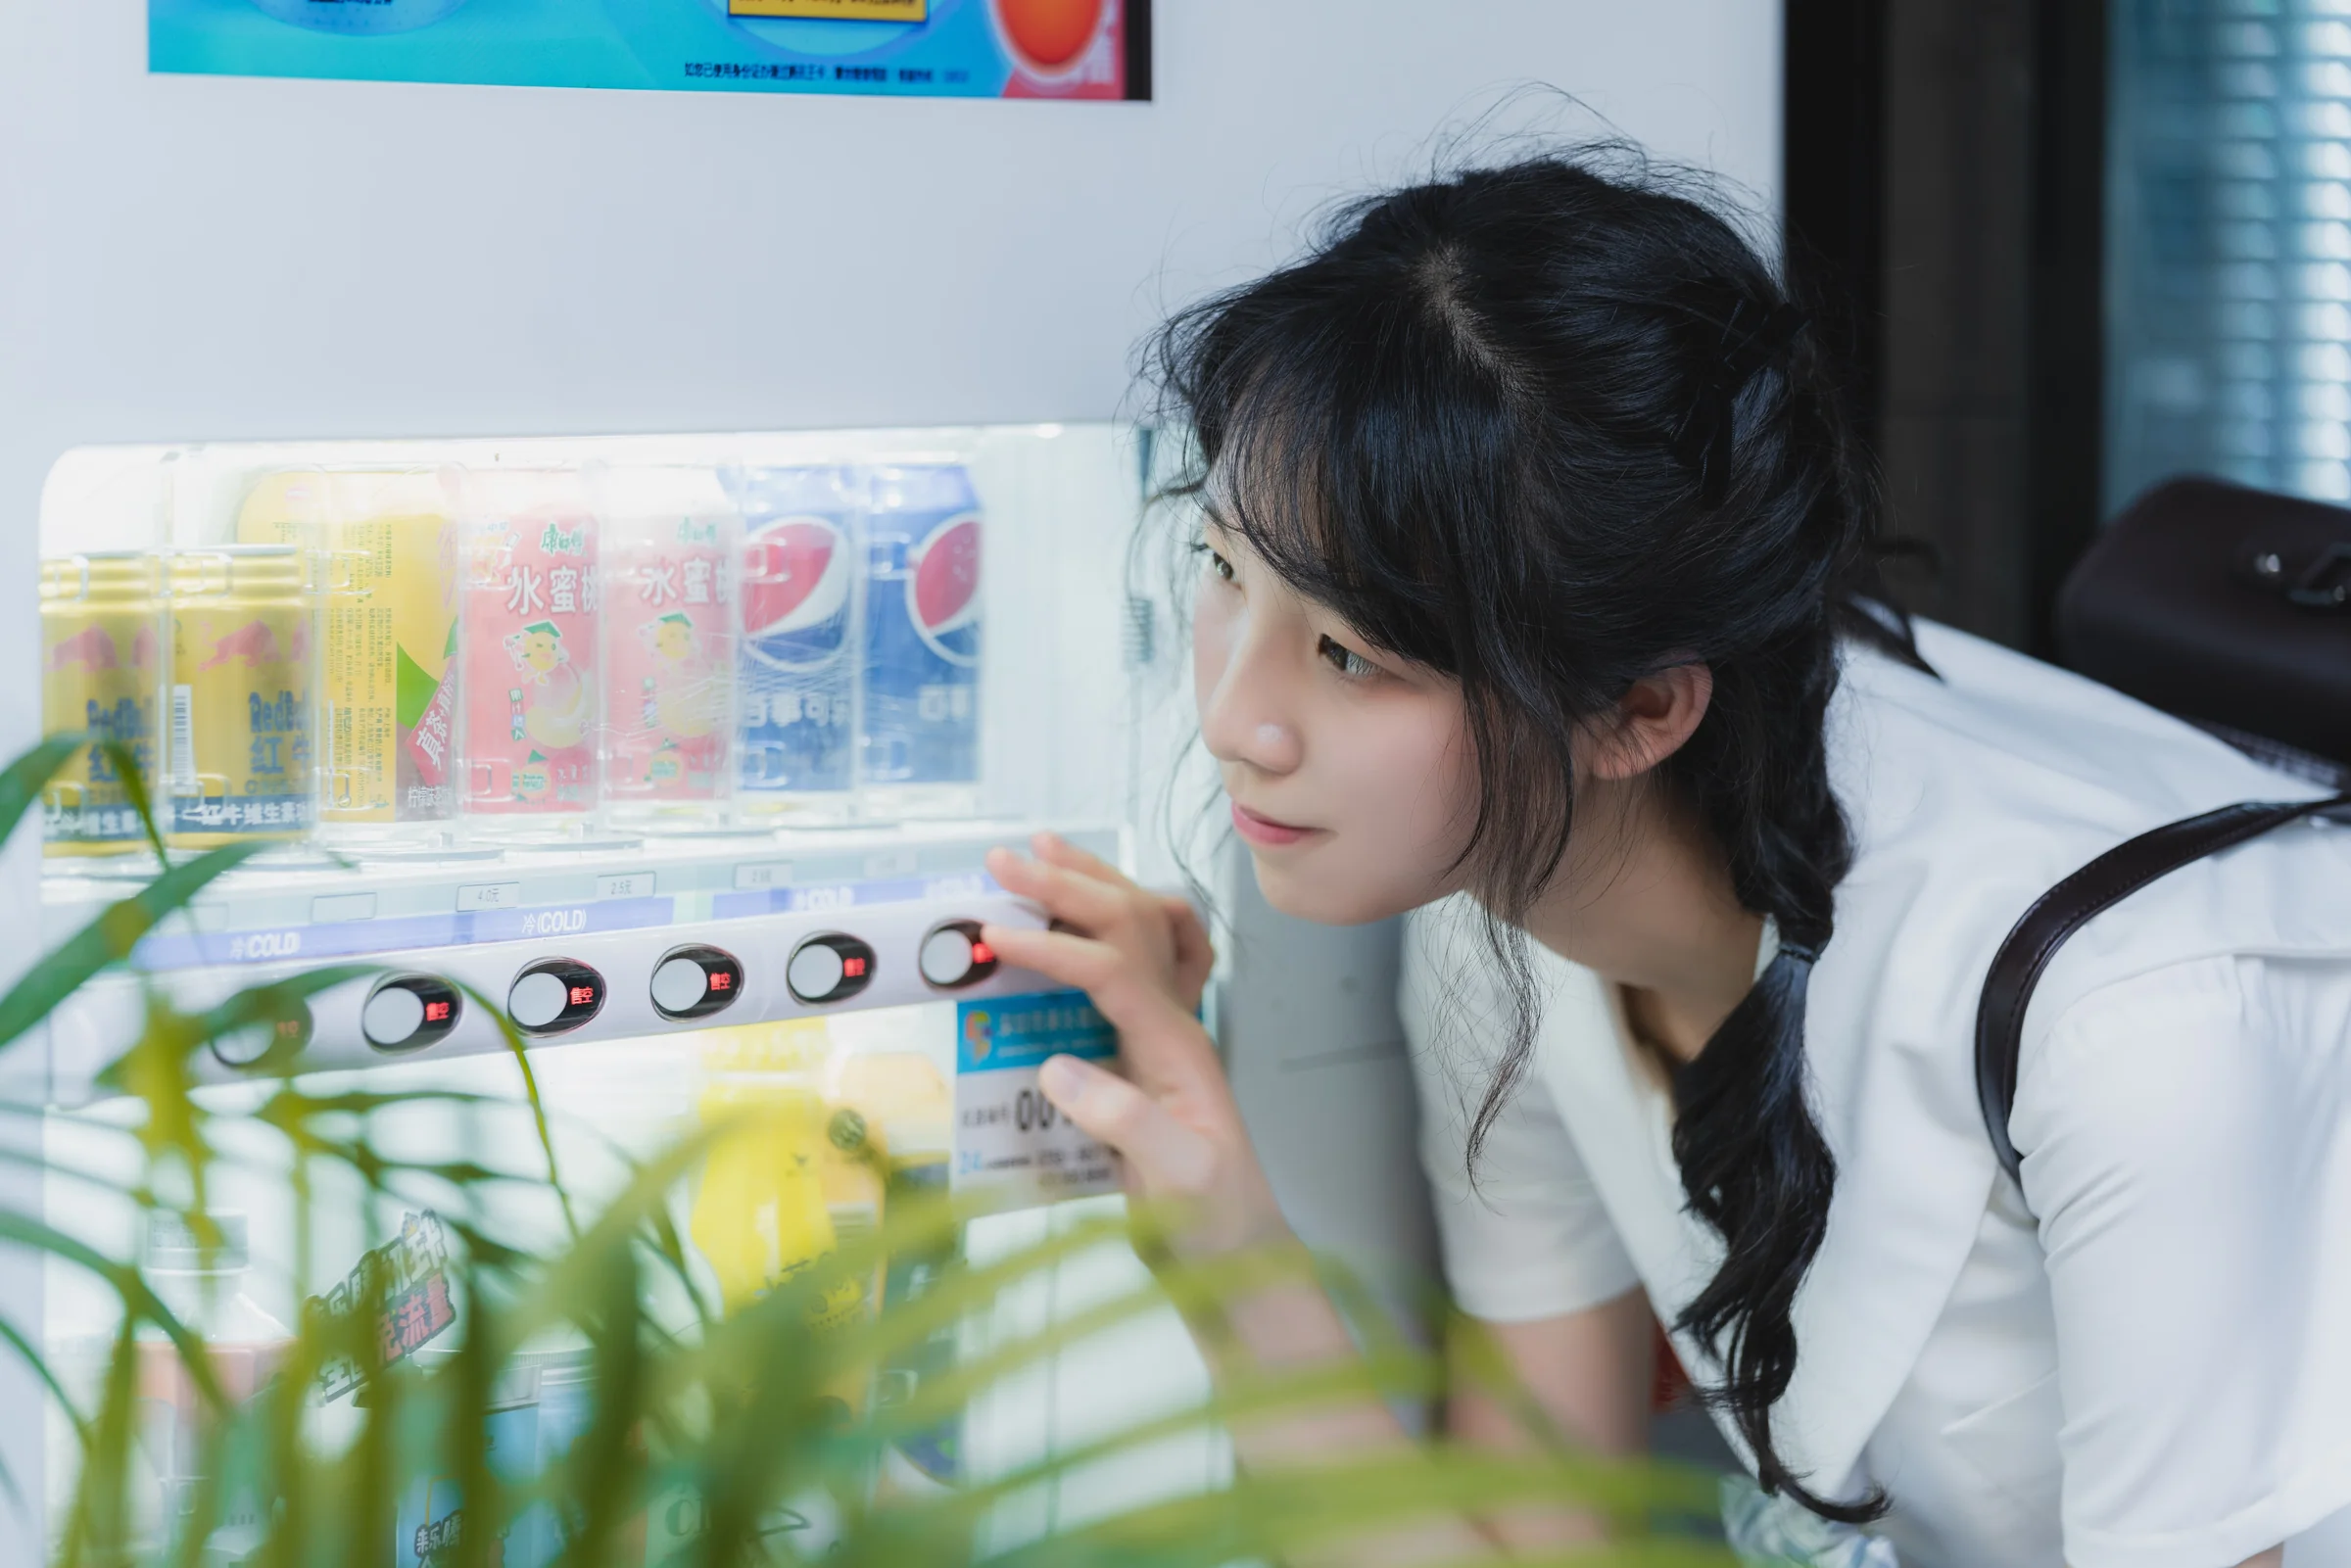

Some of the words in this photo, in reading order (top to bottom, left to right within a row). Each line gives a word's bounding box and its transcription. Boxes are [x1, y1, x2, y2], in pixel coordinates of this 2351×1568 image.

[250, 734, 312, 775] 红牛
[522, 908, 587, 936] 冷(COLD)
[570, 986, 594, 1005] 售空
